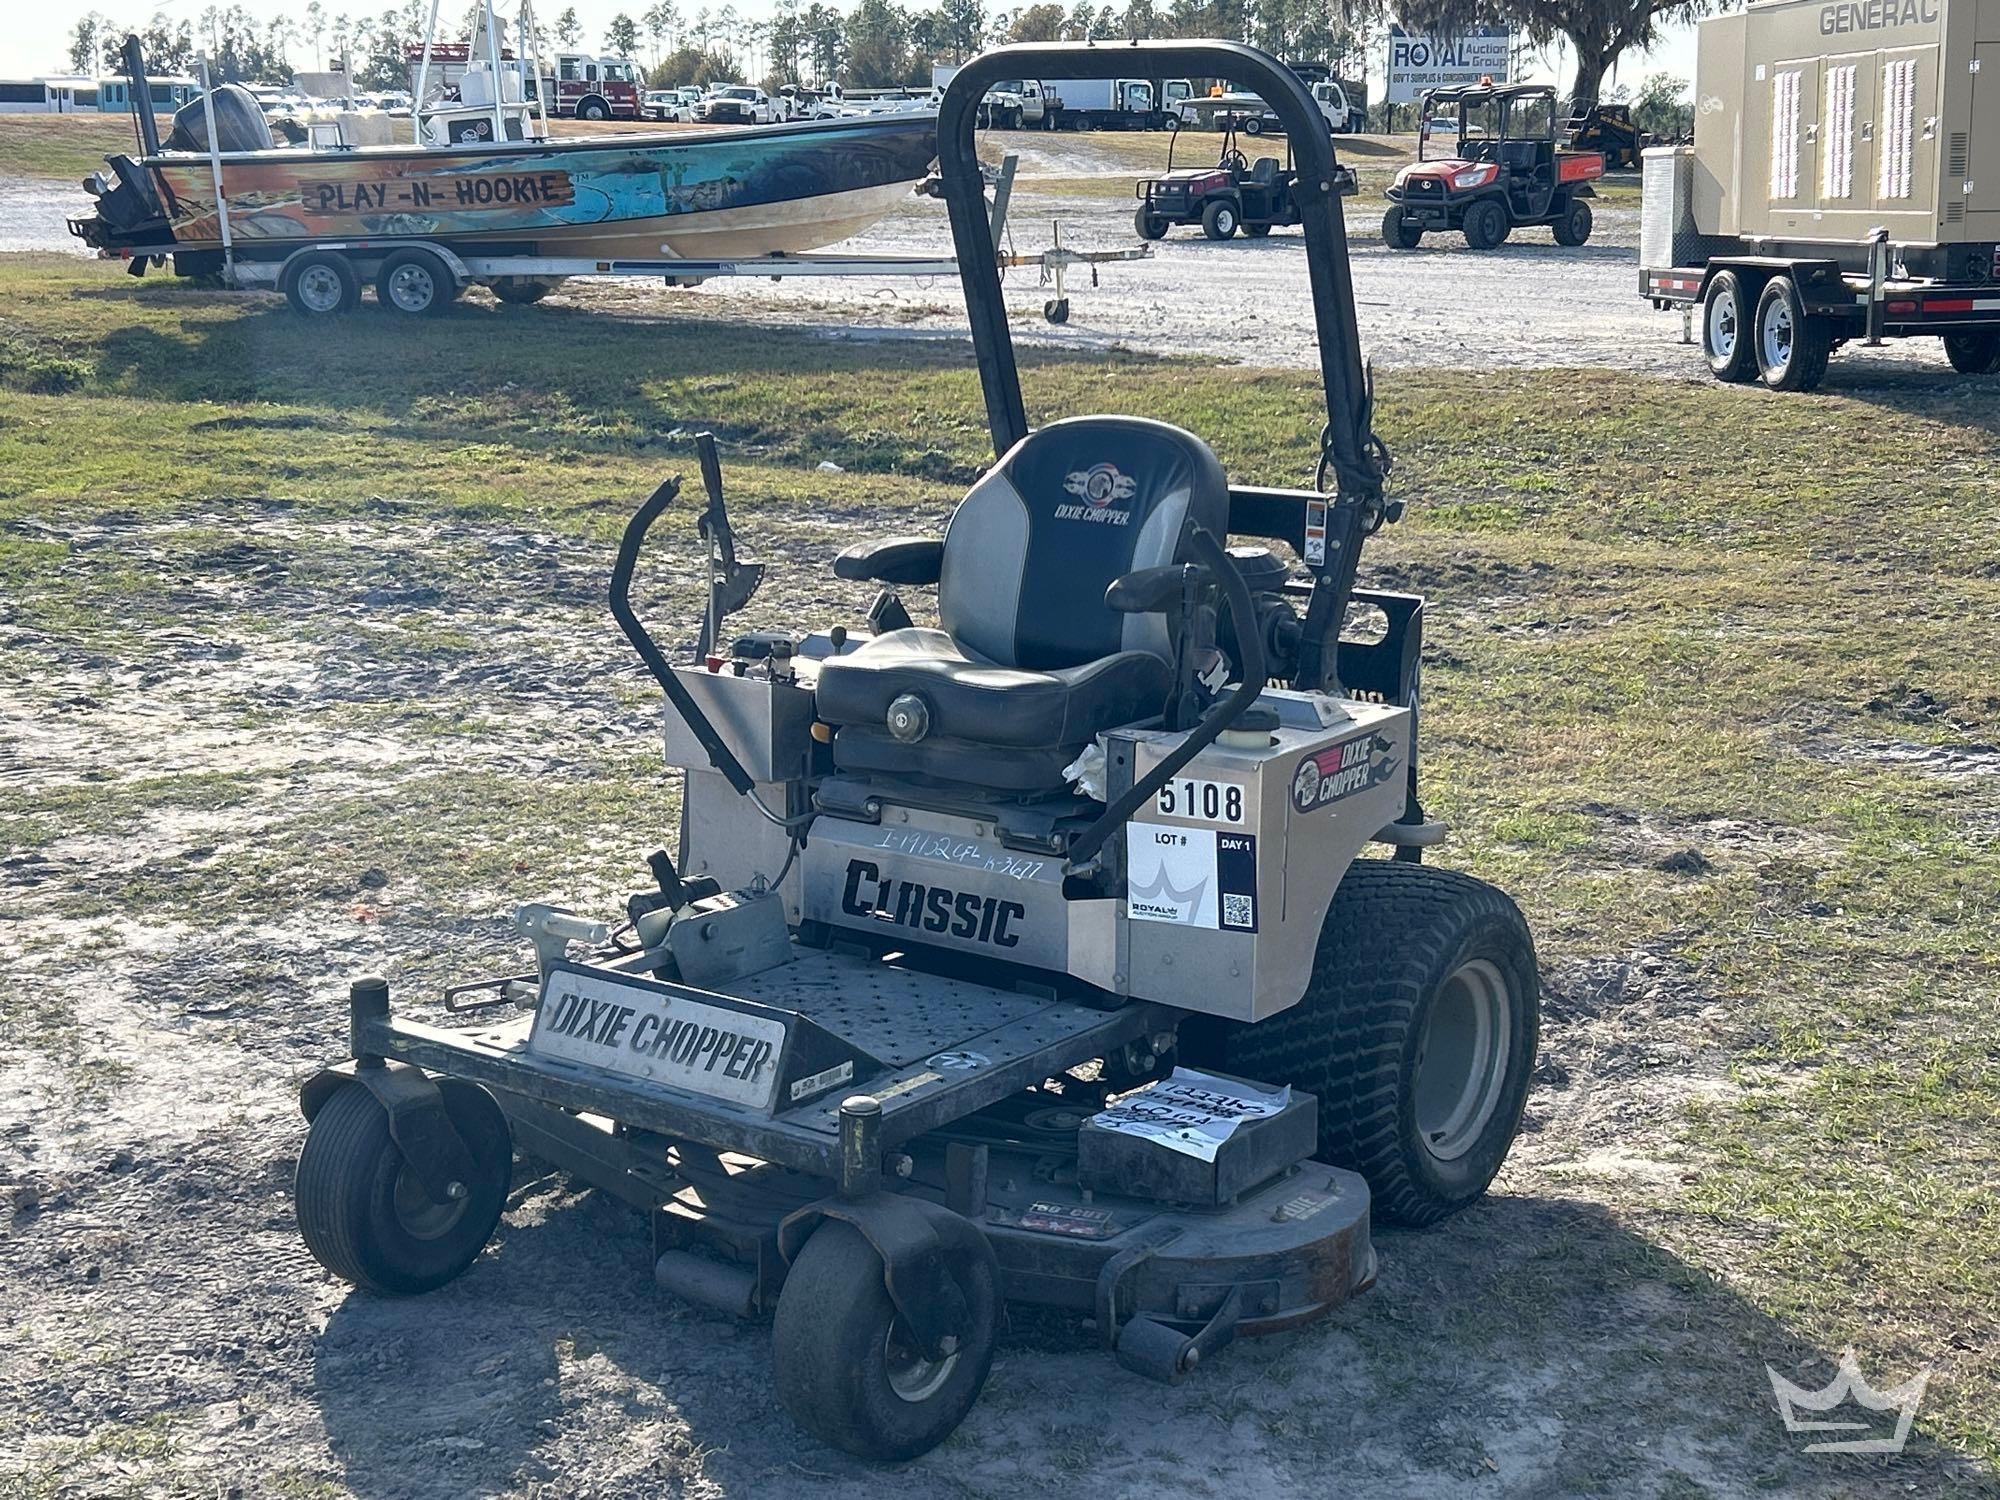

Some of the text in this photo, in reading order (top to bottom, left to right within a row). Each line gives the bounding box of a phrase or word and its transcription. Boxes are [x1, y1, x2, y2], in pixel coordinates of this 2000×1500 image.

[1820, 0, 1938, 36] GENERAC
[1394, 42, 1470, 67] ROYAL
[1466, 43, 1508, 55] Auction
[1472, 57, 1507, 69] Group
[316, 183, 387, 210] PLAY
[455, 175, 560, 205] HOOKIE
[1053, 504, 1131, 526] DIXIE CHOPPER
[1341, 736, 1373, 769] DIXIE
[1319, 762, 1371, 802] CHOPPER
[1159, 779, 1242, 822] 5108
[1155, 832, 1188, 847] LOT #
[1221, 838, 1251, 852] DAY 1
[842, 858, 1025, 948] CLASSIC
[1132, 903, 1169, 915] ROYAL
[549, 992, 773, 1085] DIXIE CHOPPER
